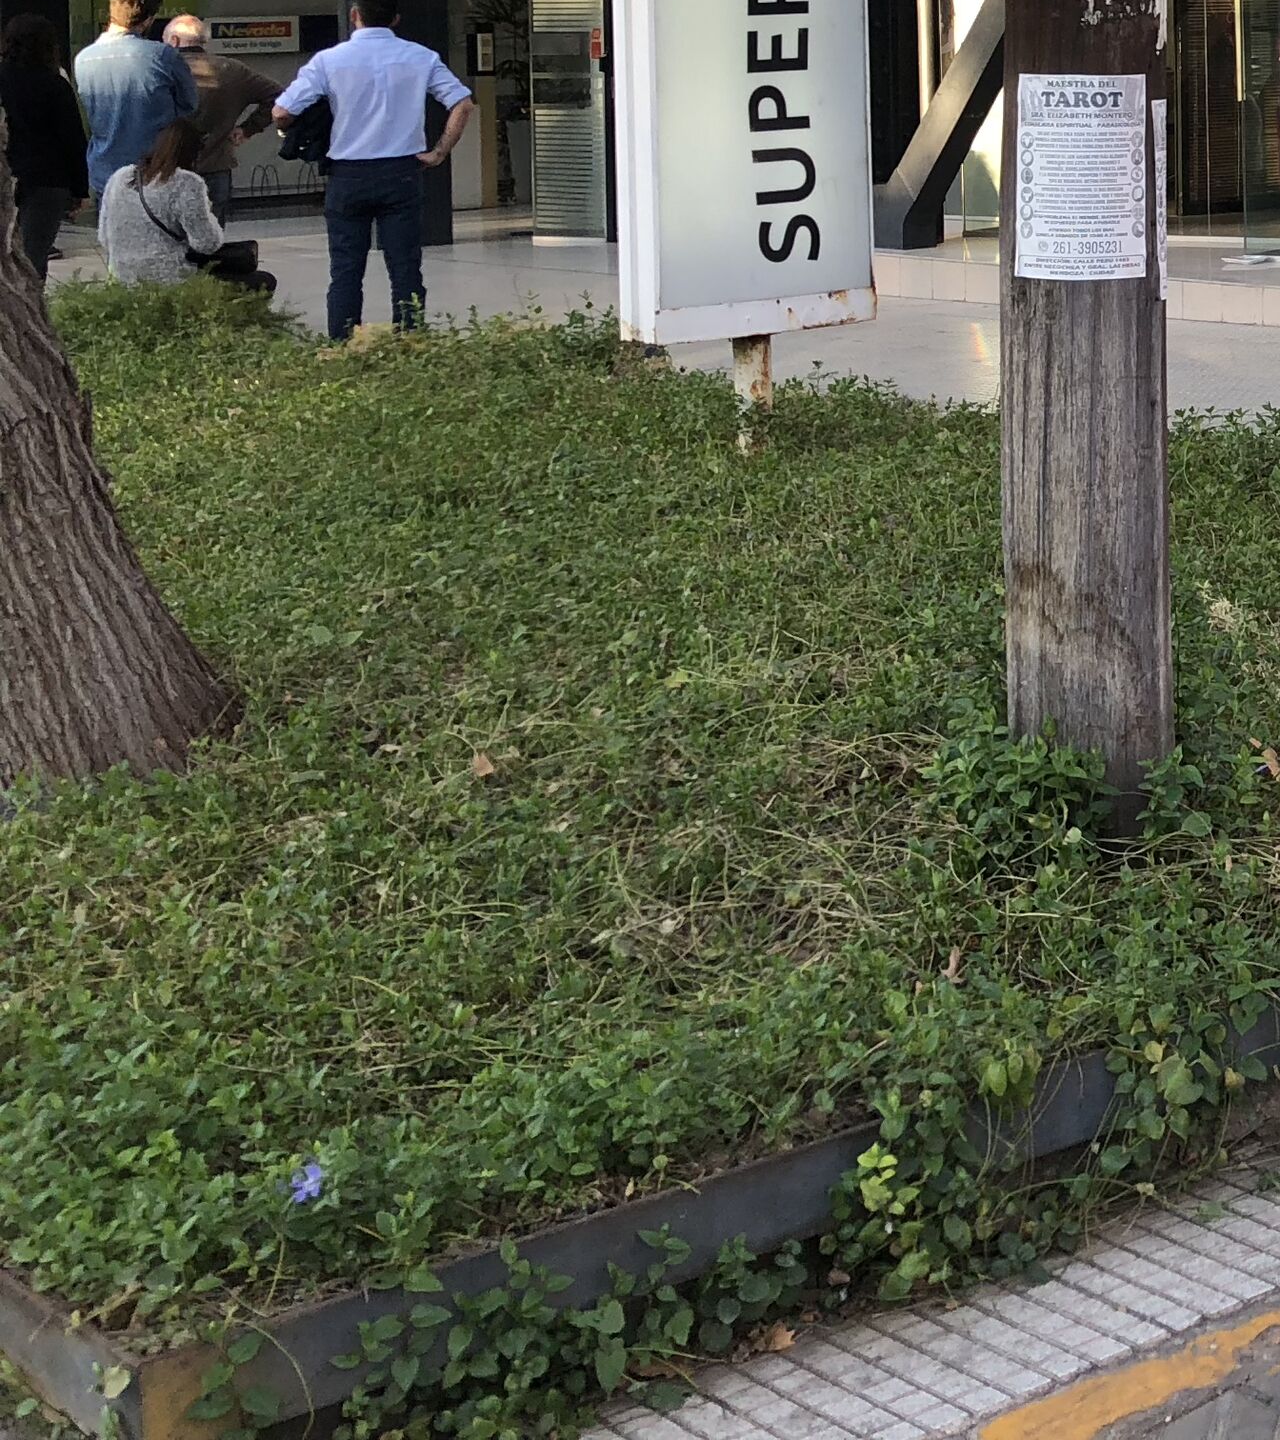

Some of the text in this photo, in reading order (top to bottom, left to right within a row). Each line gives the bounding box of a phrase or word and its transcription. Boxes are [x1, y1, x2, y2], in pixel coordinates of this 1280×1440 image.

[218, 24, 286, 37] Nevada
[1047, 79, 1118, 88] MAESTRA DEL
[1040, 91, 1124, 108] TAROT
[1047, 111, 1133, 119] ELIZABETH MONTERO
[1052, 240, 1123, 255] 261-3905231
